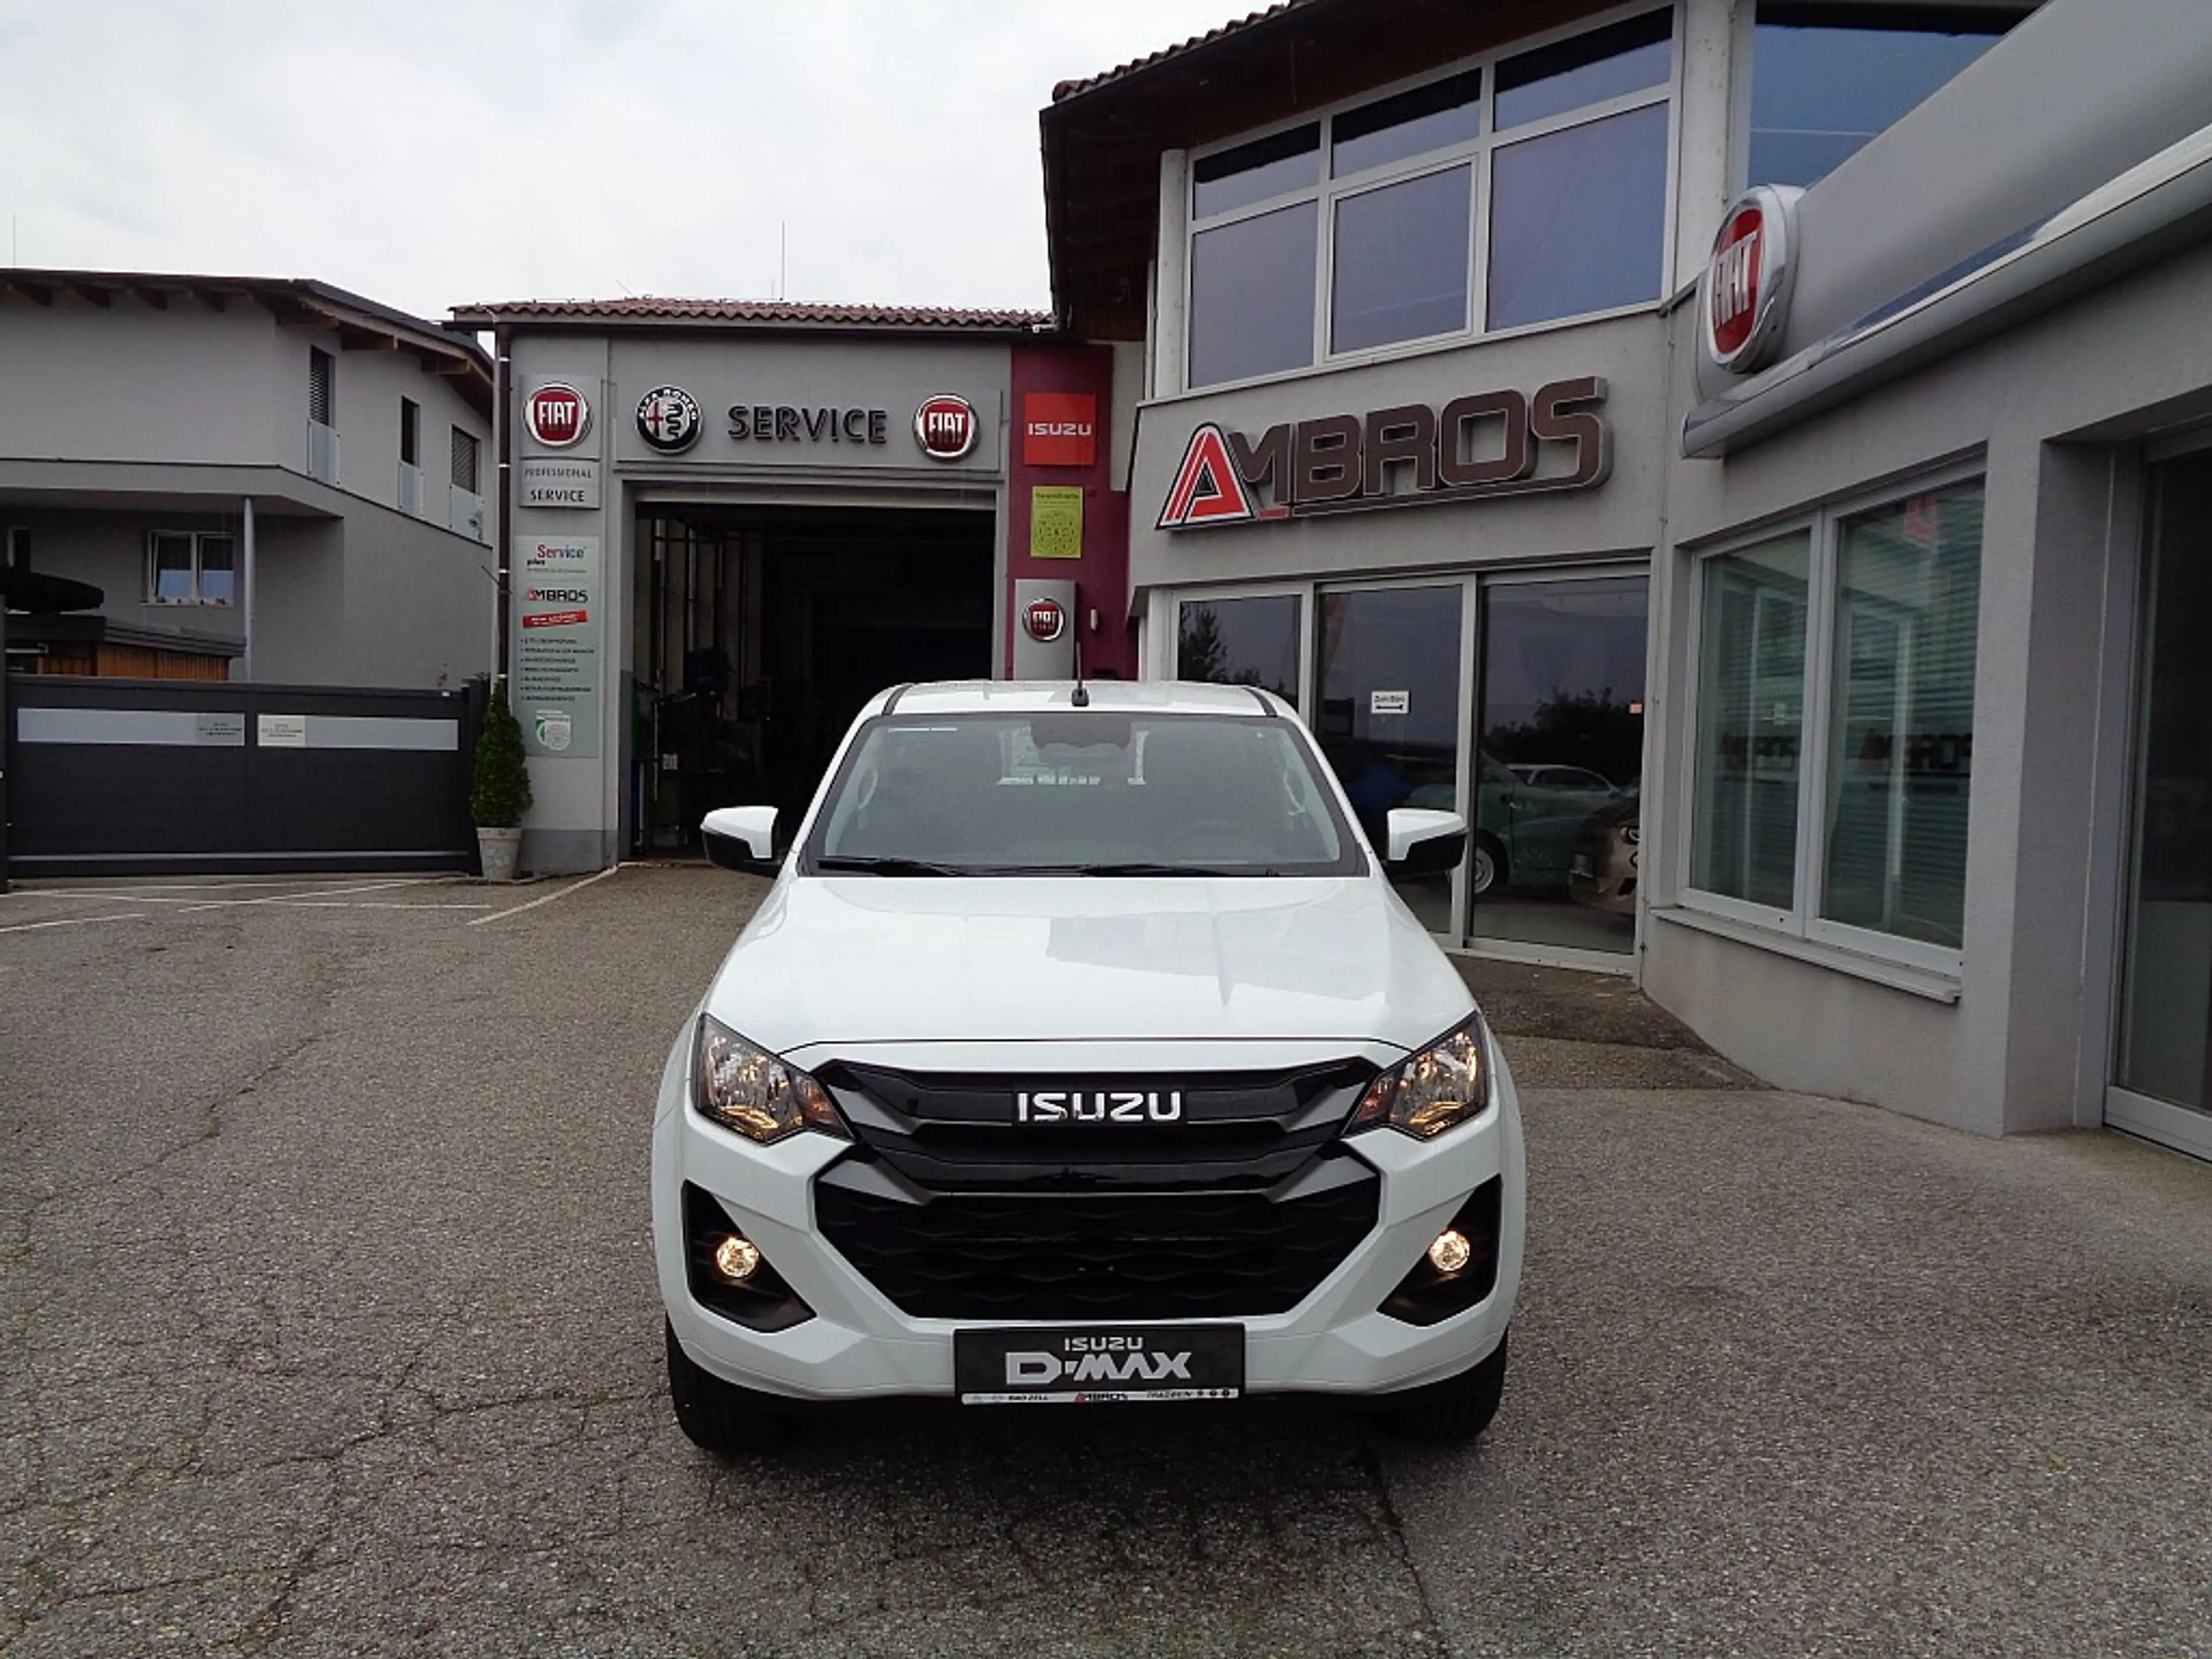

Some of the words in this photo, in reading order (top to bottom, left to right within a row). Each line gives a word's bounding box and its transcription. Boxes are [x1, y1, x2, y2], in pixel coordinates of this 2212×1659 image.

[538, 401, 575, 426] FIAT
[929, 412, 966, 433] FIAT
[727, 405, 887, 444] SERVICE
[1028, 423, 1093, 435] ISUZU
[1155, 376, 1607, 530] AMBROS
[530, 489, 586, 502] SERVICE
[537, 544, 585, 559] Service
[527, 588, 589, 604] AMBROS
[1017, 1092, 1181, 1122] ISUZU
[1065, 1336, 1145, 1351] ISUZU
[1005, 1351, 1192, 1385] D-MAX
